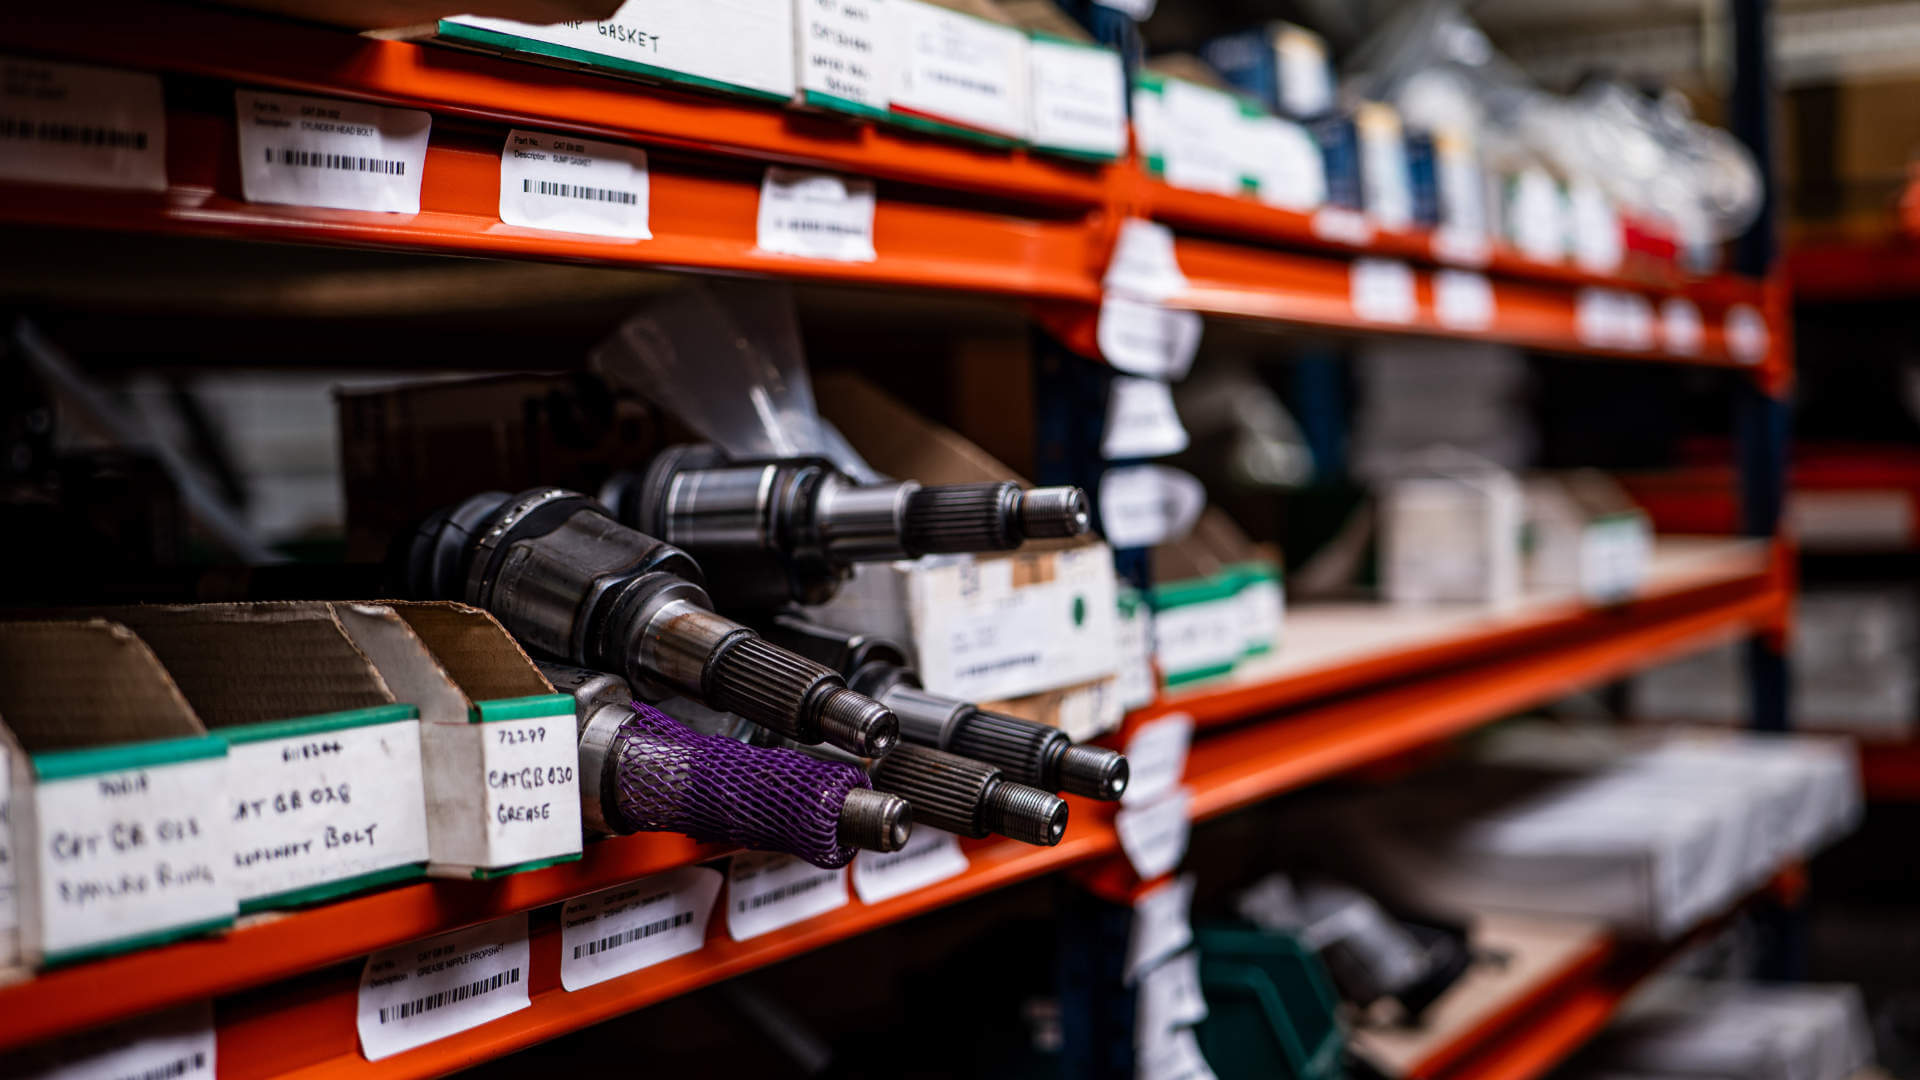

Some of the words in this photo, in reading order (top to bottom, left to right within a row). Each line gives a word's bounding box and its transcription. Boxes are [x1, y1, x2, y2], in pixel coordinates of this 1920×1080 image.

[301, 120, 335, 133] CYLINDER
[336, 124, 355, 135] HEAD
[356, 127, 375, 137] BOLT
[514, 136, 528, 145] Part
[497, 803, 550, 824] GREASE
[325, 823, 378, 849] BOLT
[417, 961, 445, 977] GREASE
[445, 954, 469, 969] NIPPLE
[469, 942, 505, 961] PROPSHAFT
